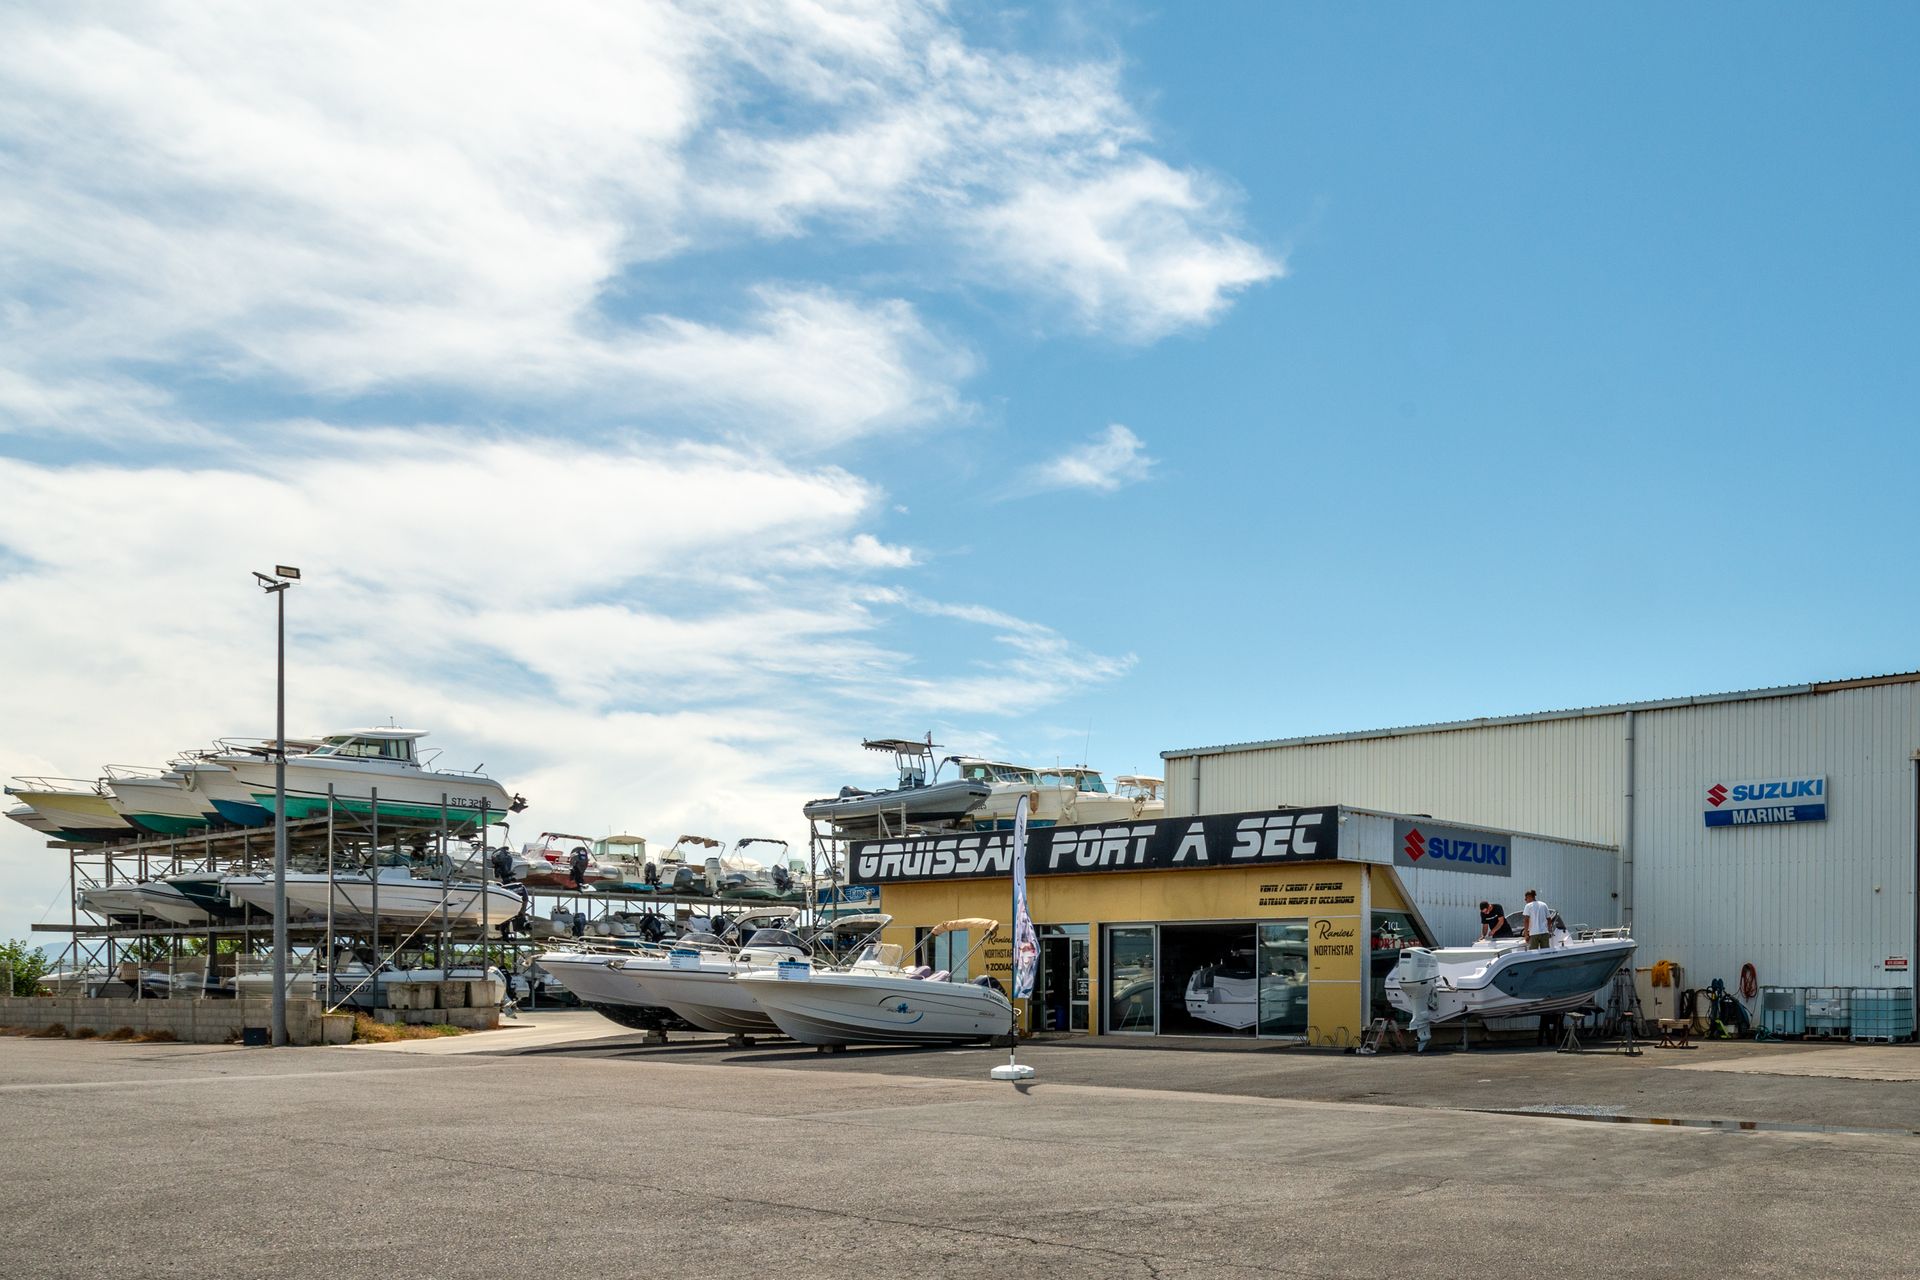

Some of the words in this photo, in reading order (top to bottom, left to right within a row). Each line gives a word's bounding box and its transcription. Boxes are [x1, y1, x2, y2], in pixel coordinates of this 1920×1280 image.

[1732, 779, 1823, 802] SUZUKI
[468, 799, 492, 809] 3216
[1732, 806, 1796, 824] MARINE
[1049, 825, 1157, 868] PORT
[1172, 822, 1208, 862] A
[1231, 813, 1323, 858] SEC
[1428, 837, 1506, 866] SUZUKI
[1314, 919, 1355, 940] Ranieri
[1313, 944, 1355, 957] NORTHSTAR
